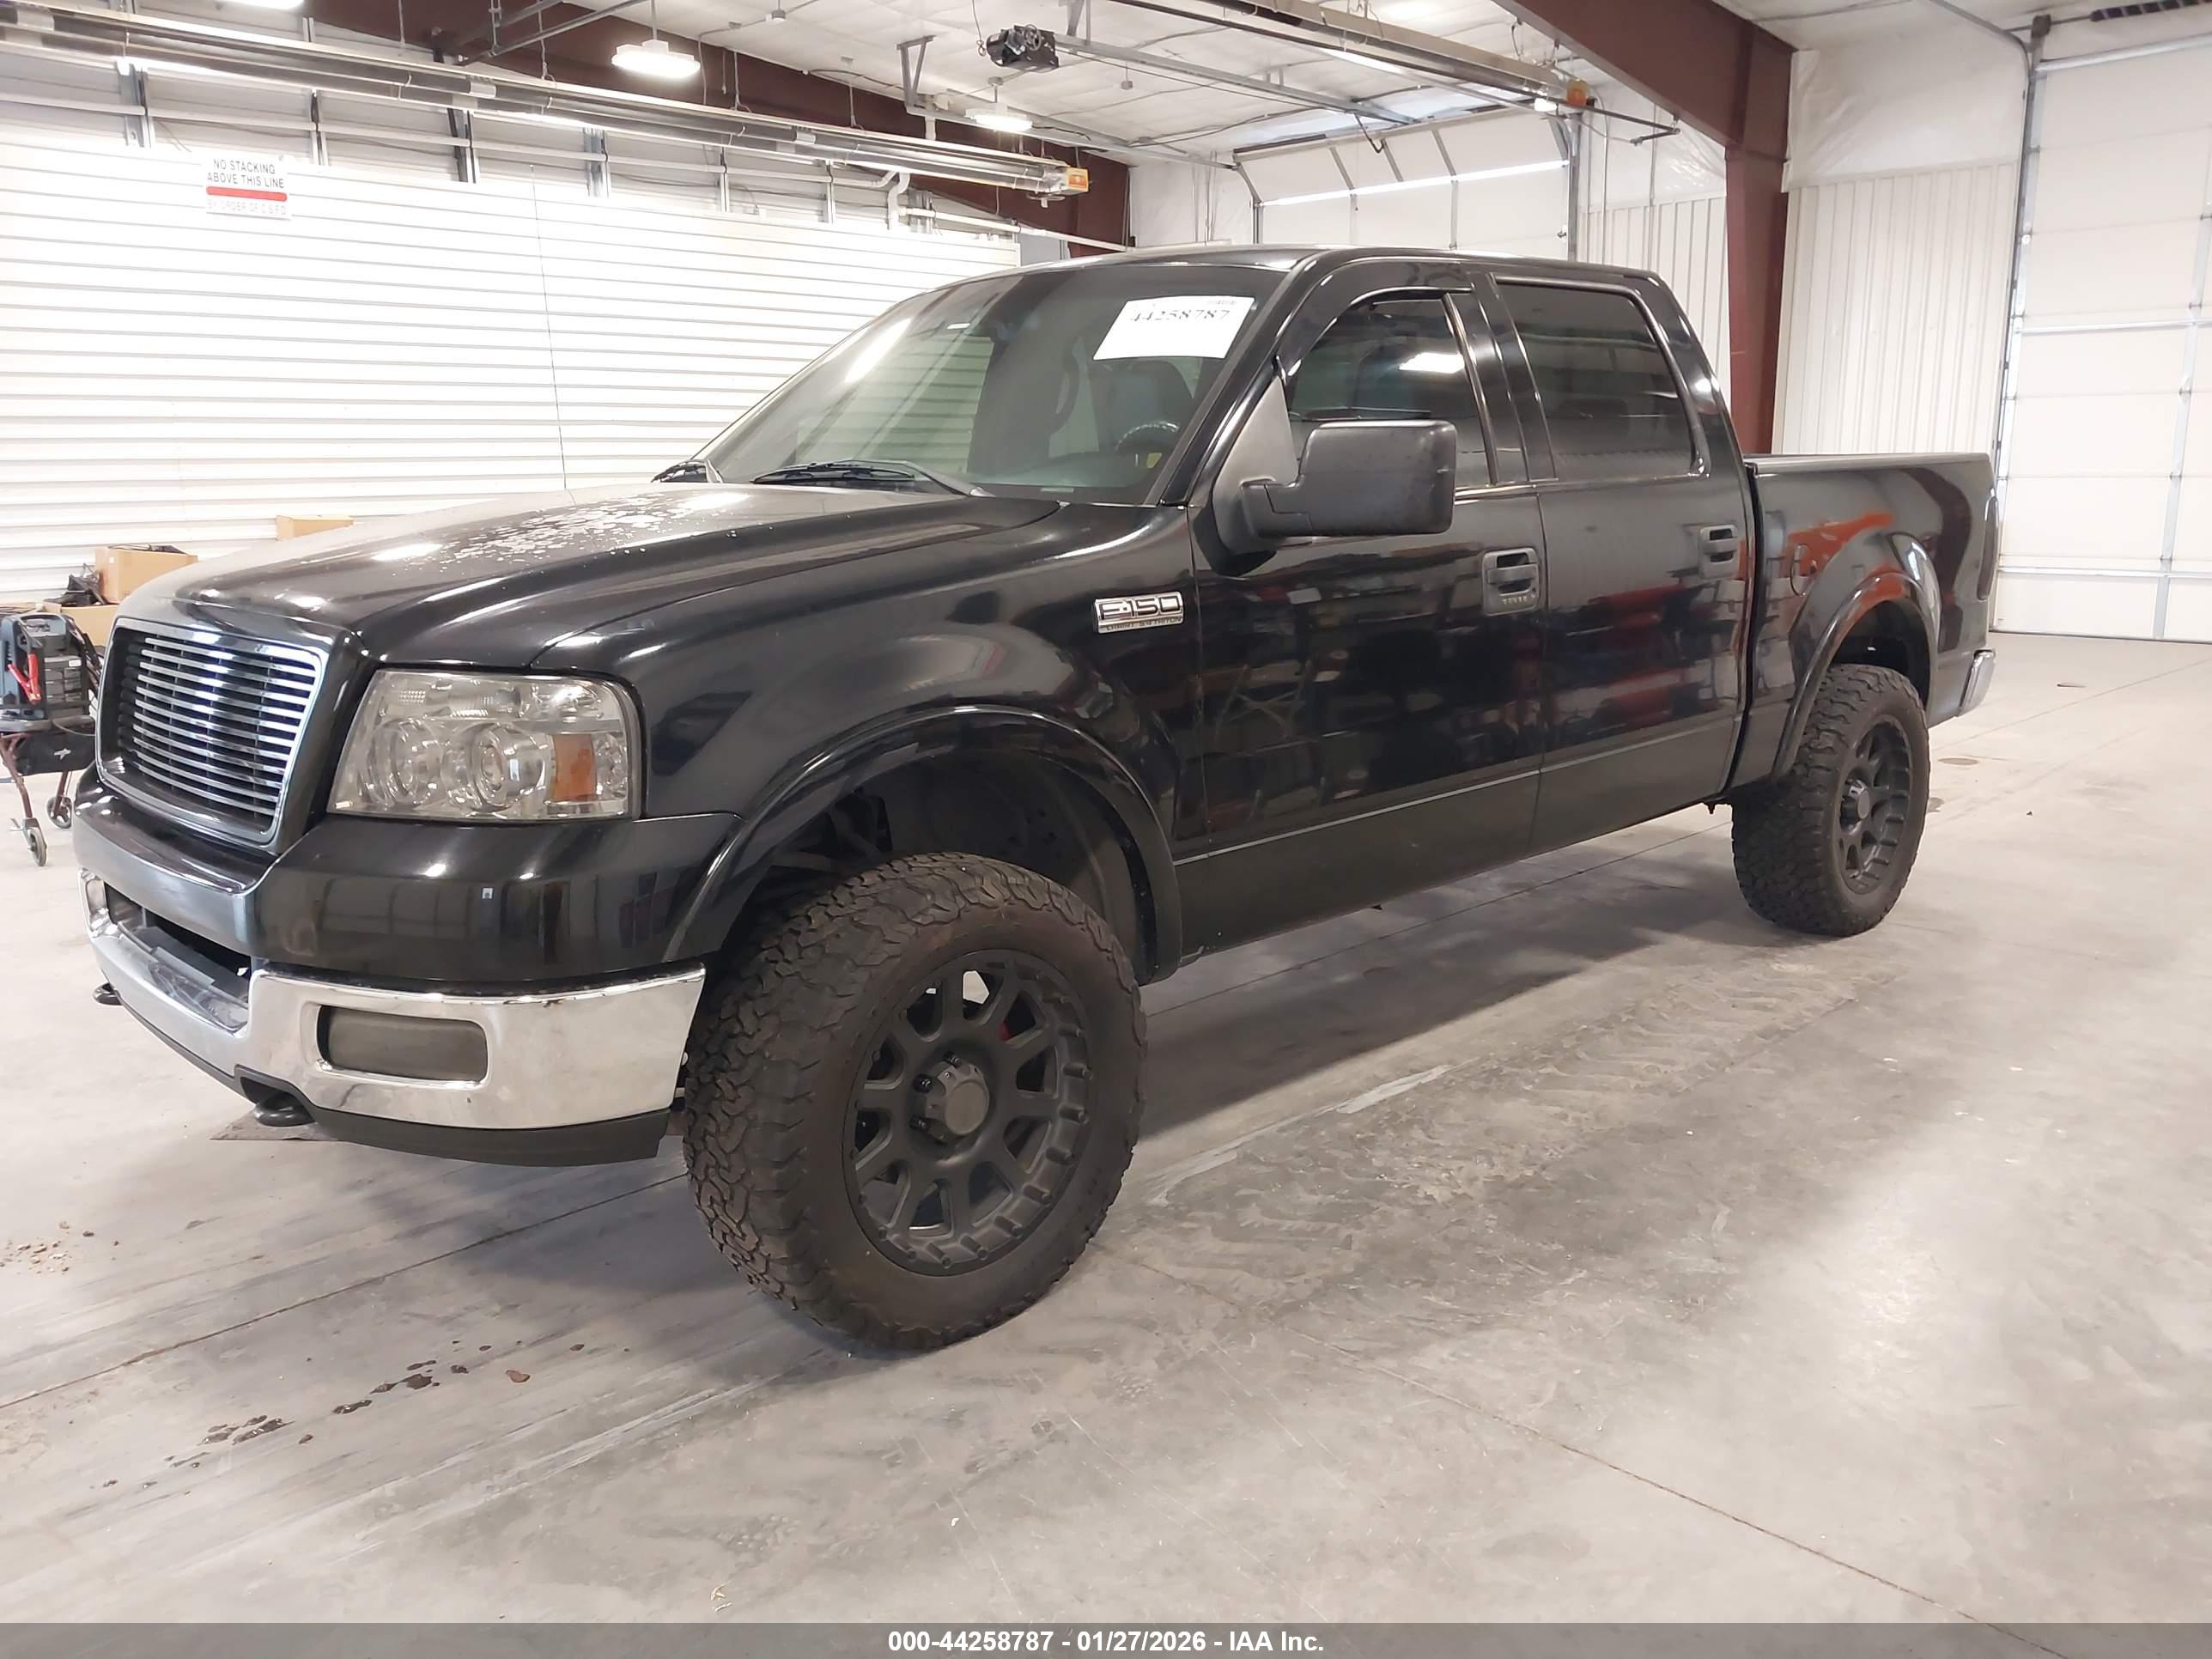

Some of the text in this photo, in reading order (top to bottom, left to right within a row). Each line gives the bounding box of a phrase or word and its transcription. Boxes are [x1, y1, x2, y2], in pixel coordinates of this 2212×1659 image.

[213, 158, 276, 175] NO STACKING
[207, 172, 284, 189] ABOVE THIS LINE
[1099, 595, 1182, 620] F-150
